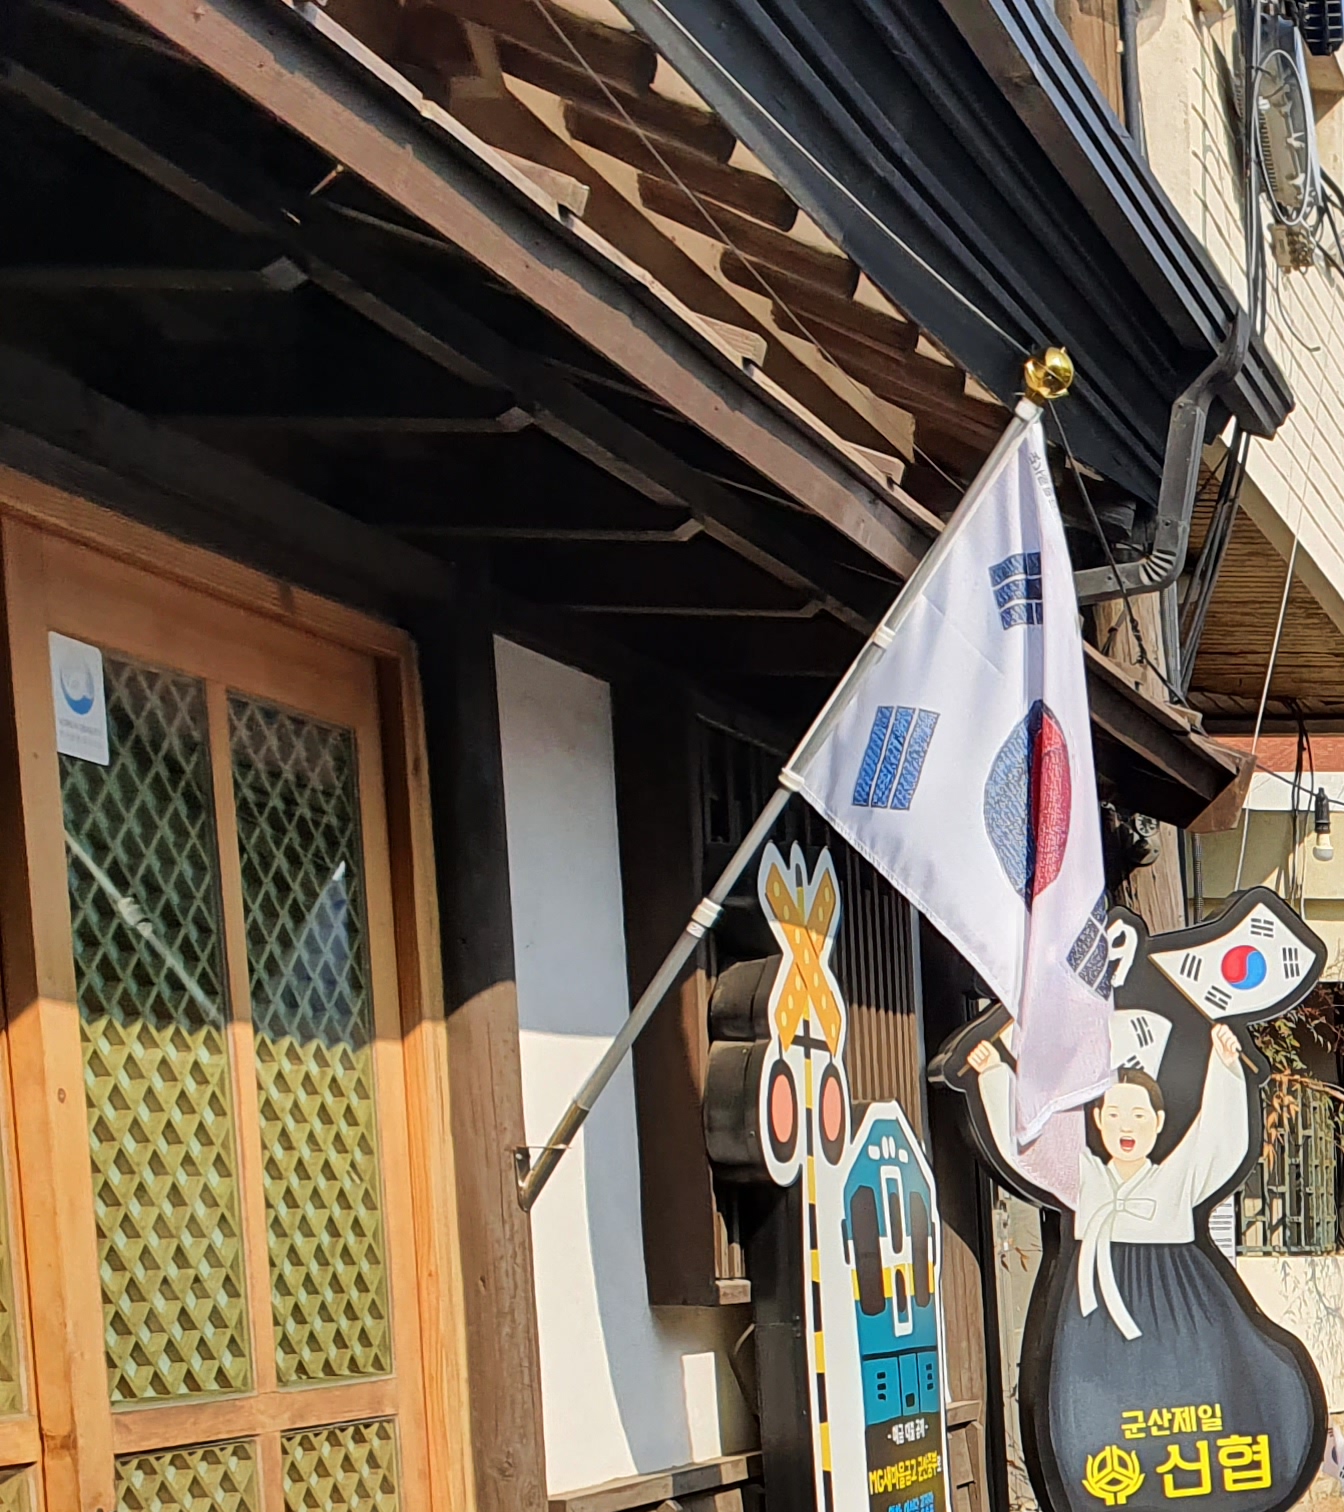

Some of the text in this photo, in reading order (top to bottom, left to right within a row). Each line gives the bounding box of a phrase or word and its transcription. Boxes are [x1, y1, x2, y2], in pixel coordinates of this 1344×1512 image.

[1121, 1403, 1223, 1439] 군산제일
[868, 1458, 917, 1495] MG새마을금고
[1155, 1434, 1272, 1499] 신협
